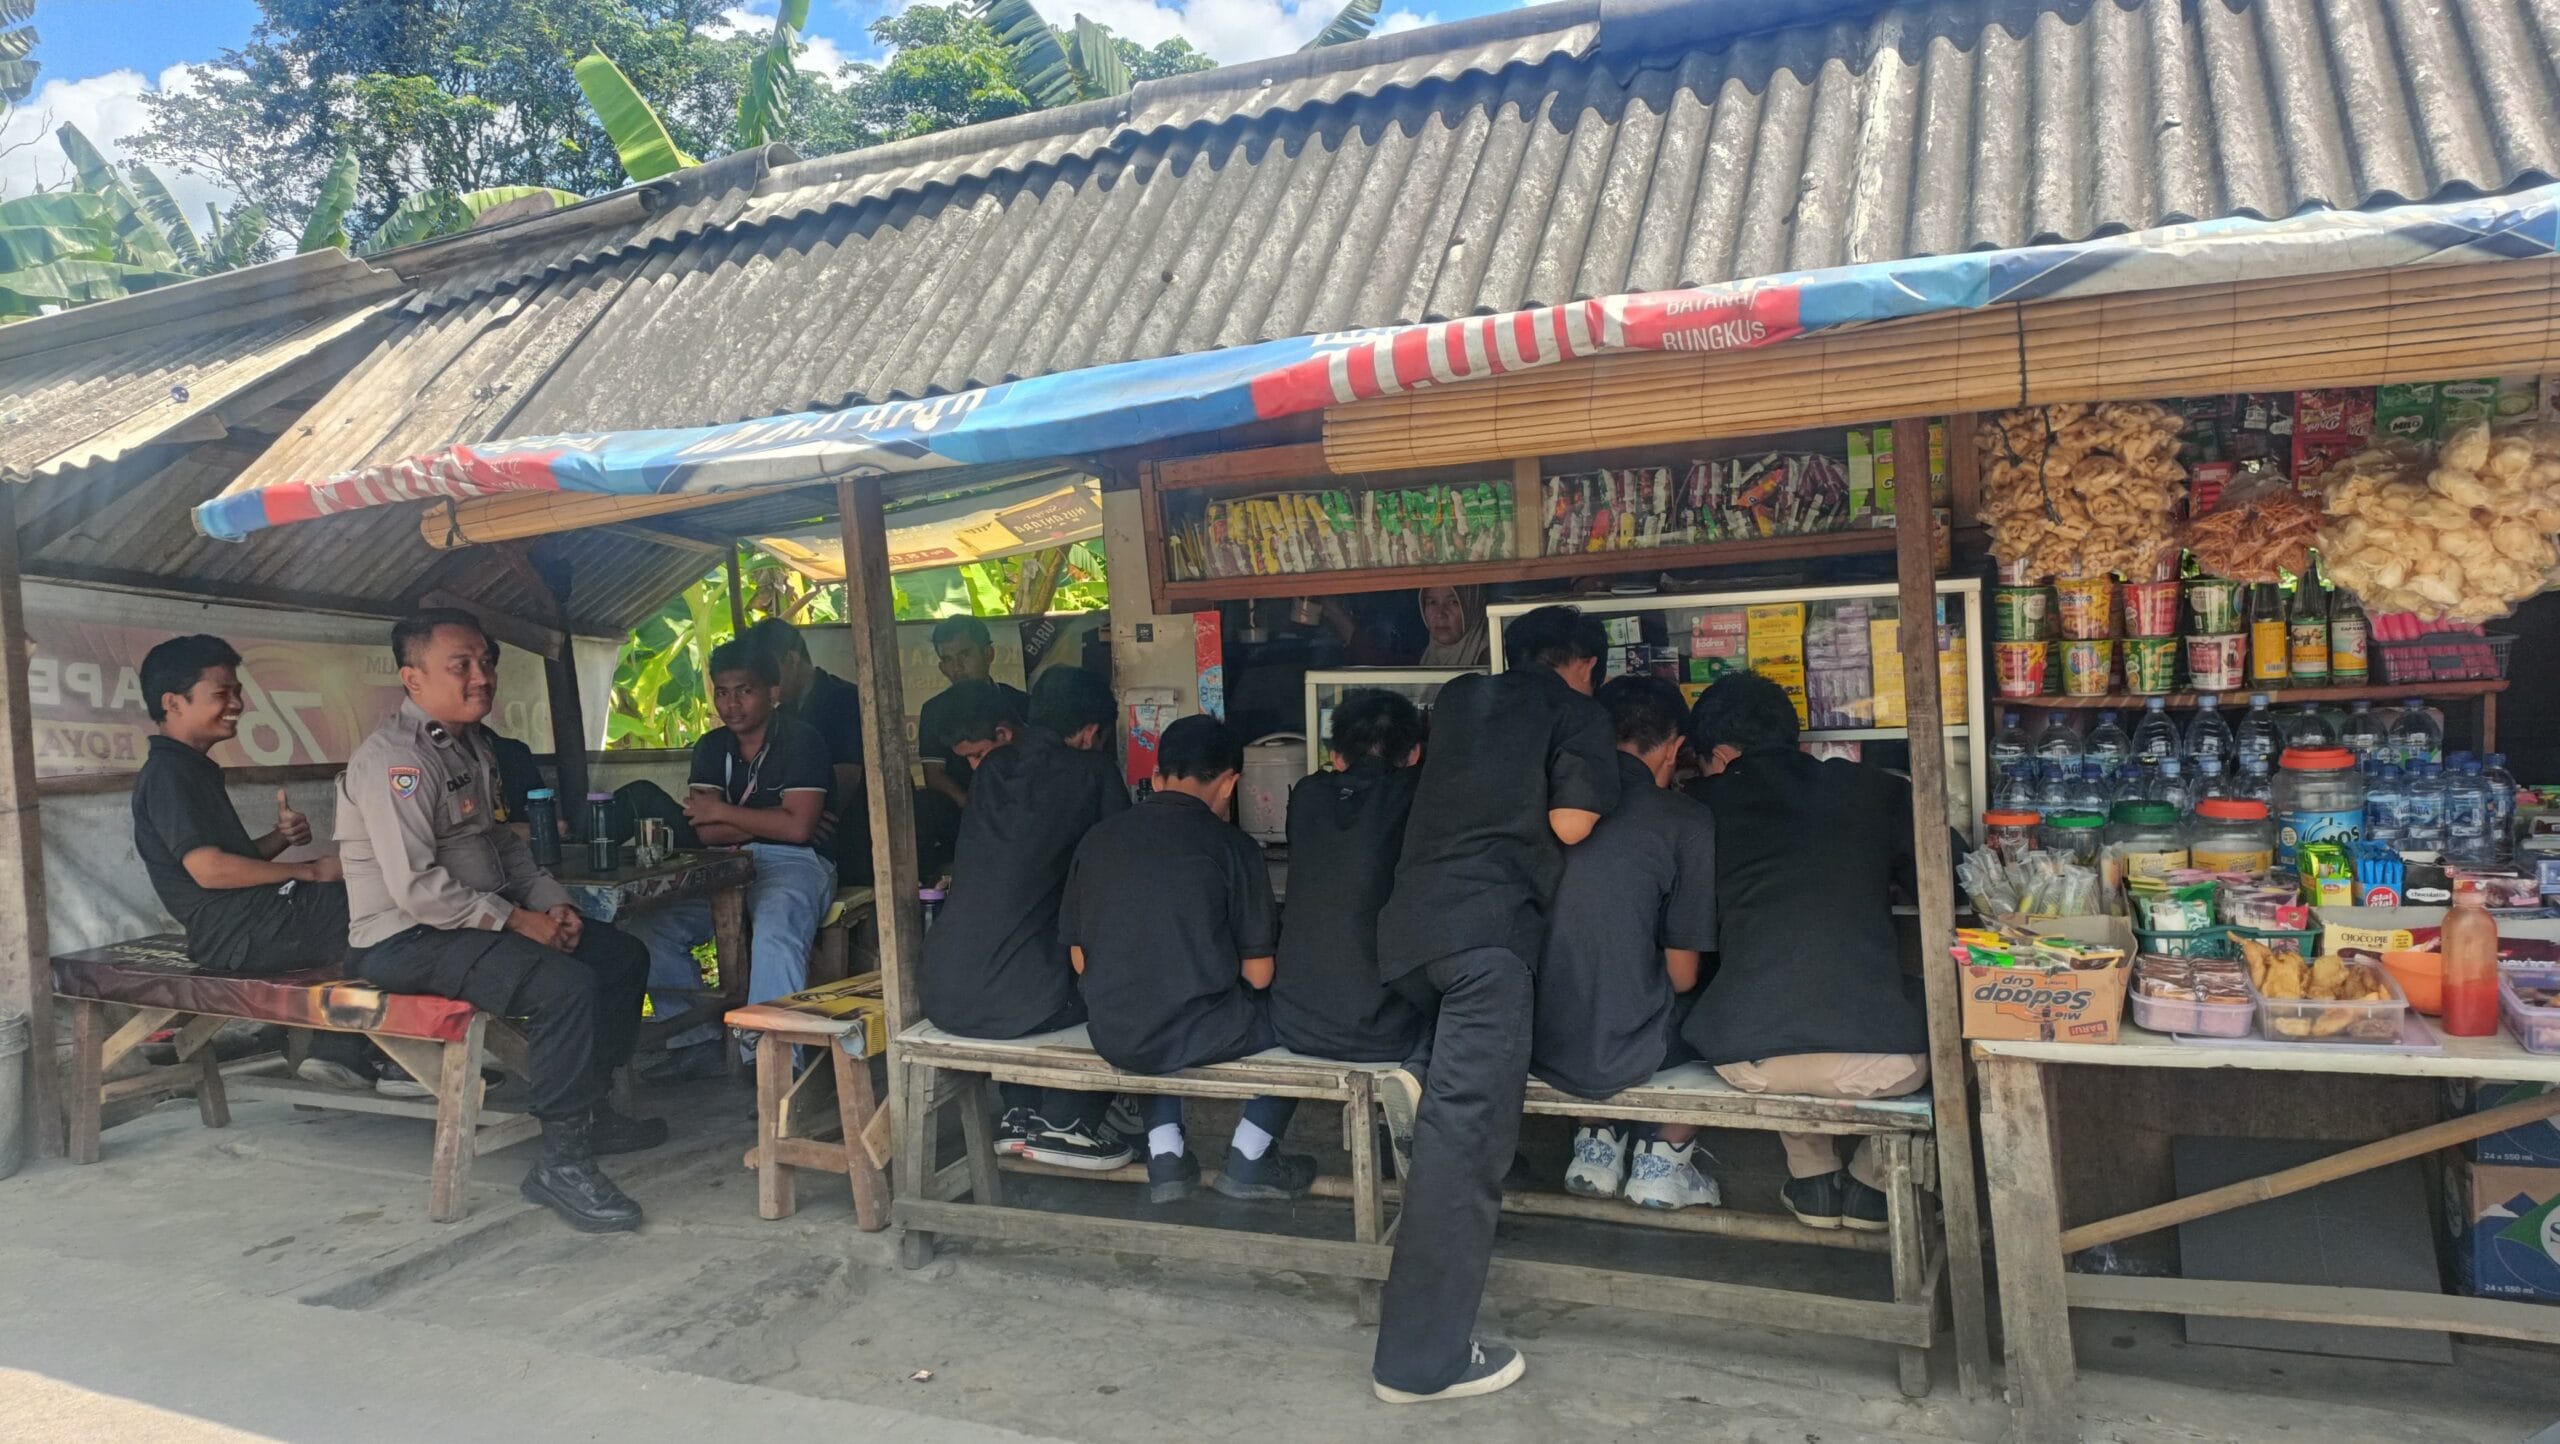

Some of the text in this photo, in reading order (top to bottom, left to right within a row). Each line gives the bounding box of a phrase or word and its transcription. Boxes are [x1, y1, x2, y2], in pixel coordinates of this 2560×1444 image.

[2392, 420, 2420, 431] MILO
[1026, 620, 1056, 657] BARU
[2341, 933, 2374, 943] CHOCO
[2374, 935, 2389, 944] PIE
[2001, 974, 2034, 988] Cup
[1974, 982, 2093, 1010] Sedaap
[2054, 1011, 2083, 1021] Mie
[2484, 1152, 2495, 1160] 24
[2504, 1153, 2520, 1161] 550
[2522, 1153, 2533, 1161] ml
[2485, 1284, 2496, 1292] 24
[2504, 1285, 2521, 1293] 550
[2522, 1285, 2534, 1294] ml
